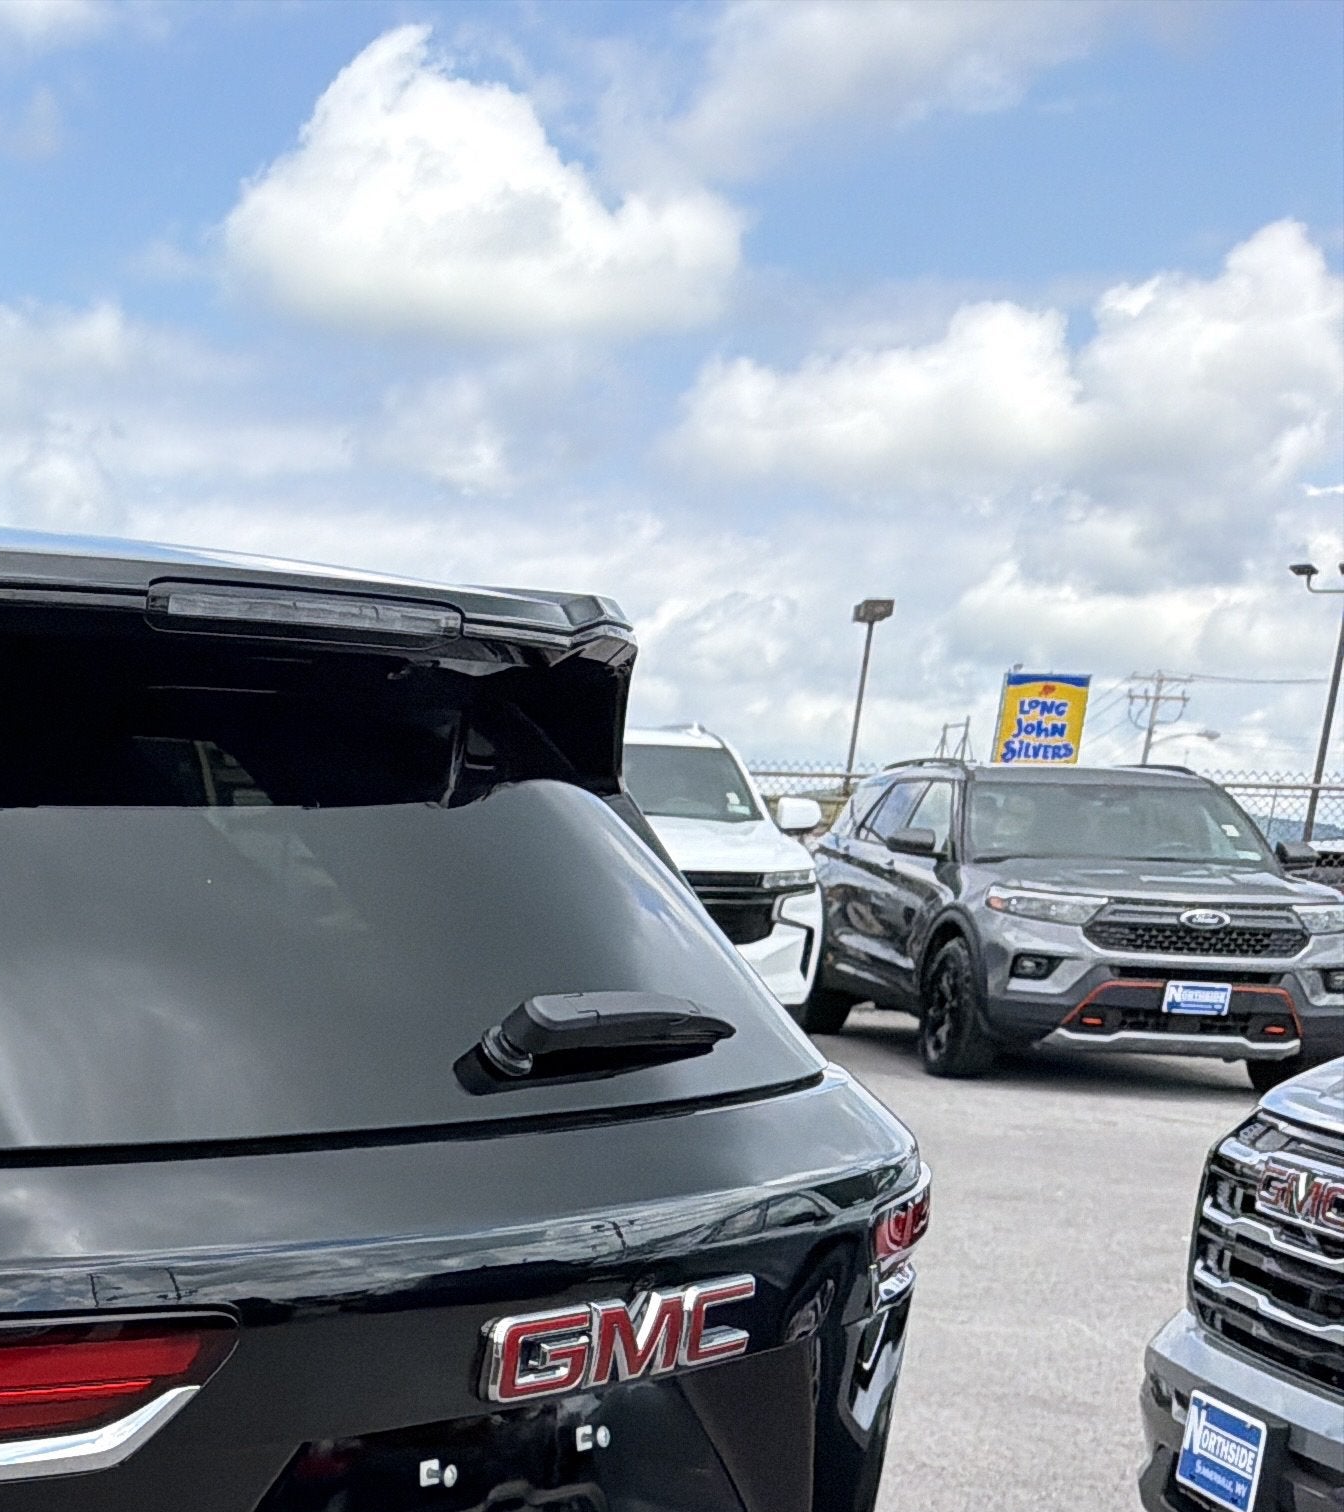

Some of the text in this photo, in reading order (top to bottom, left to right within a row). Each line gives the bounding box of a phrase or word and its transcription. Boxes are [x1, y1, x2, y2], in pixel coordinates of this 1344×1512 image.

[1019, 699, 1069, 717] LONG
[1001, 740, 1074, 763] SILVERS
[484, 1273, 756, 1402] GMC
[1183, 1404, 1257, 1473] NORTHSIDE
